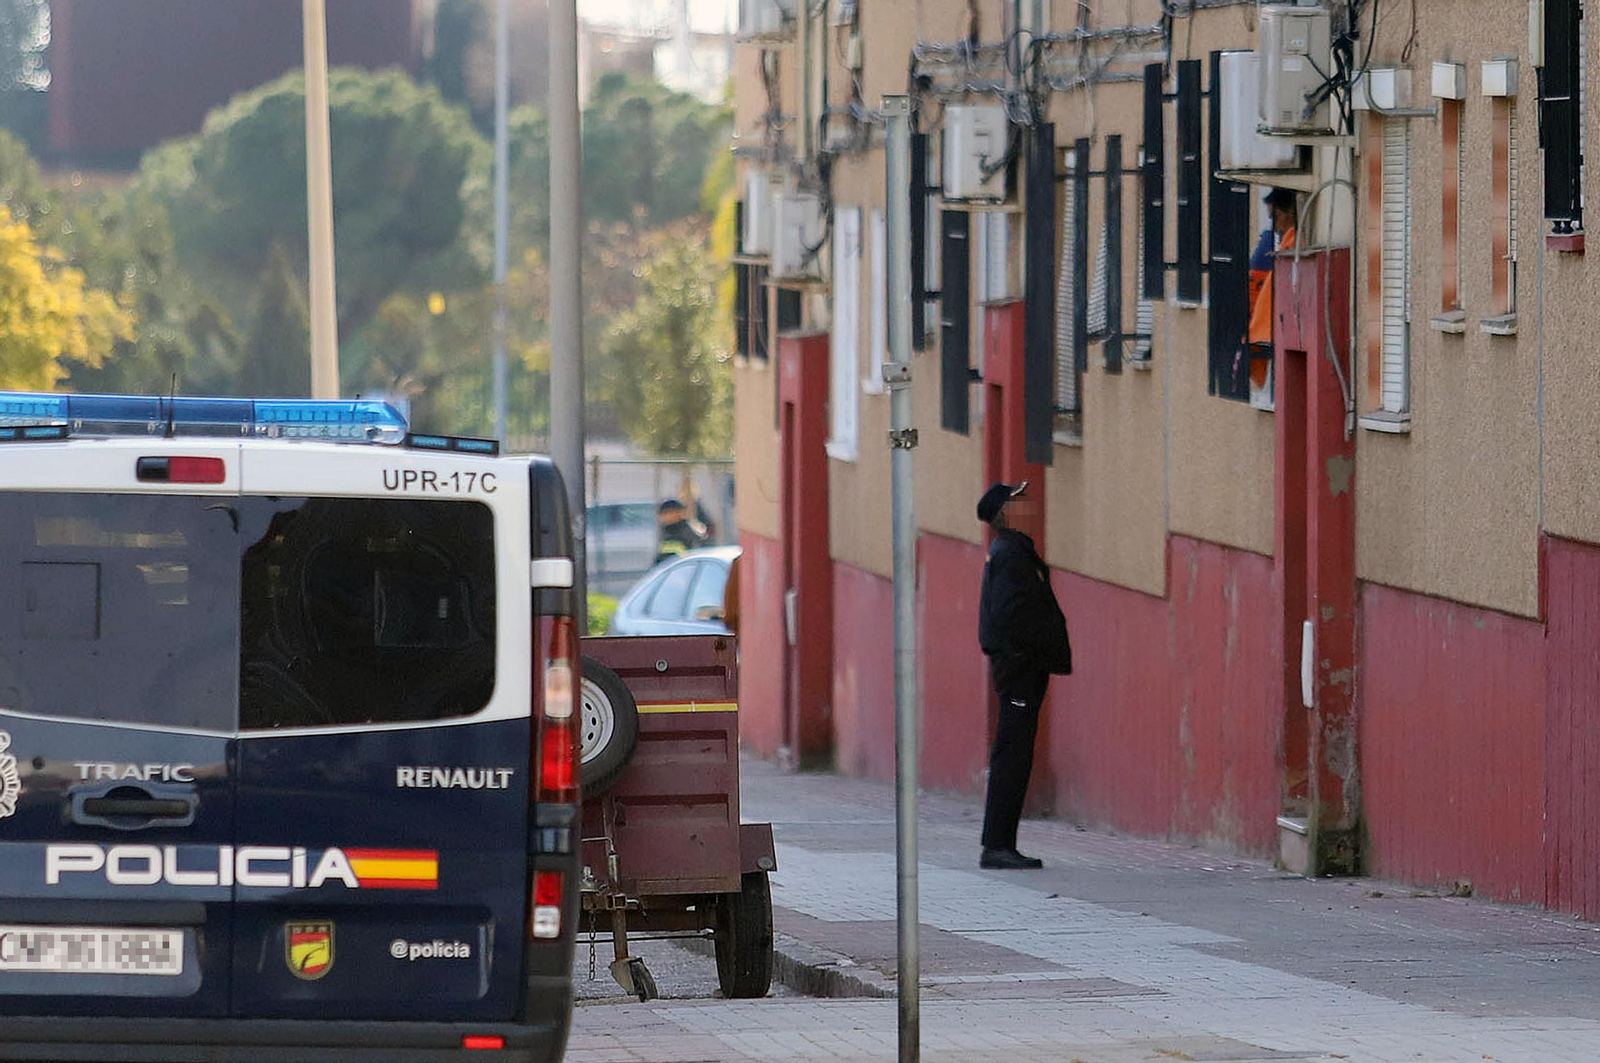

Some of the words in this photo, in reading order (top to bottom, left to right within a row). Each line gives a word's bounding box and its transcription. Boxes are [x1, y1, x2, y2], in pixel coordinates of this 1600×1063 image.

[383, 469, 497, 493] UPR-17C
[73, 763, 195, 782] TRAFIC
[396, 765, 514, 789] RENAULT
[390, 939, 470, 961] @policia
